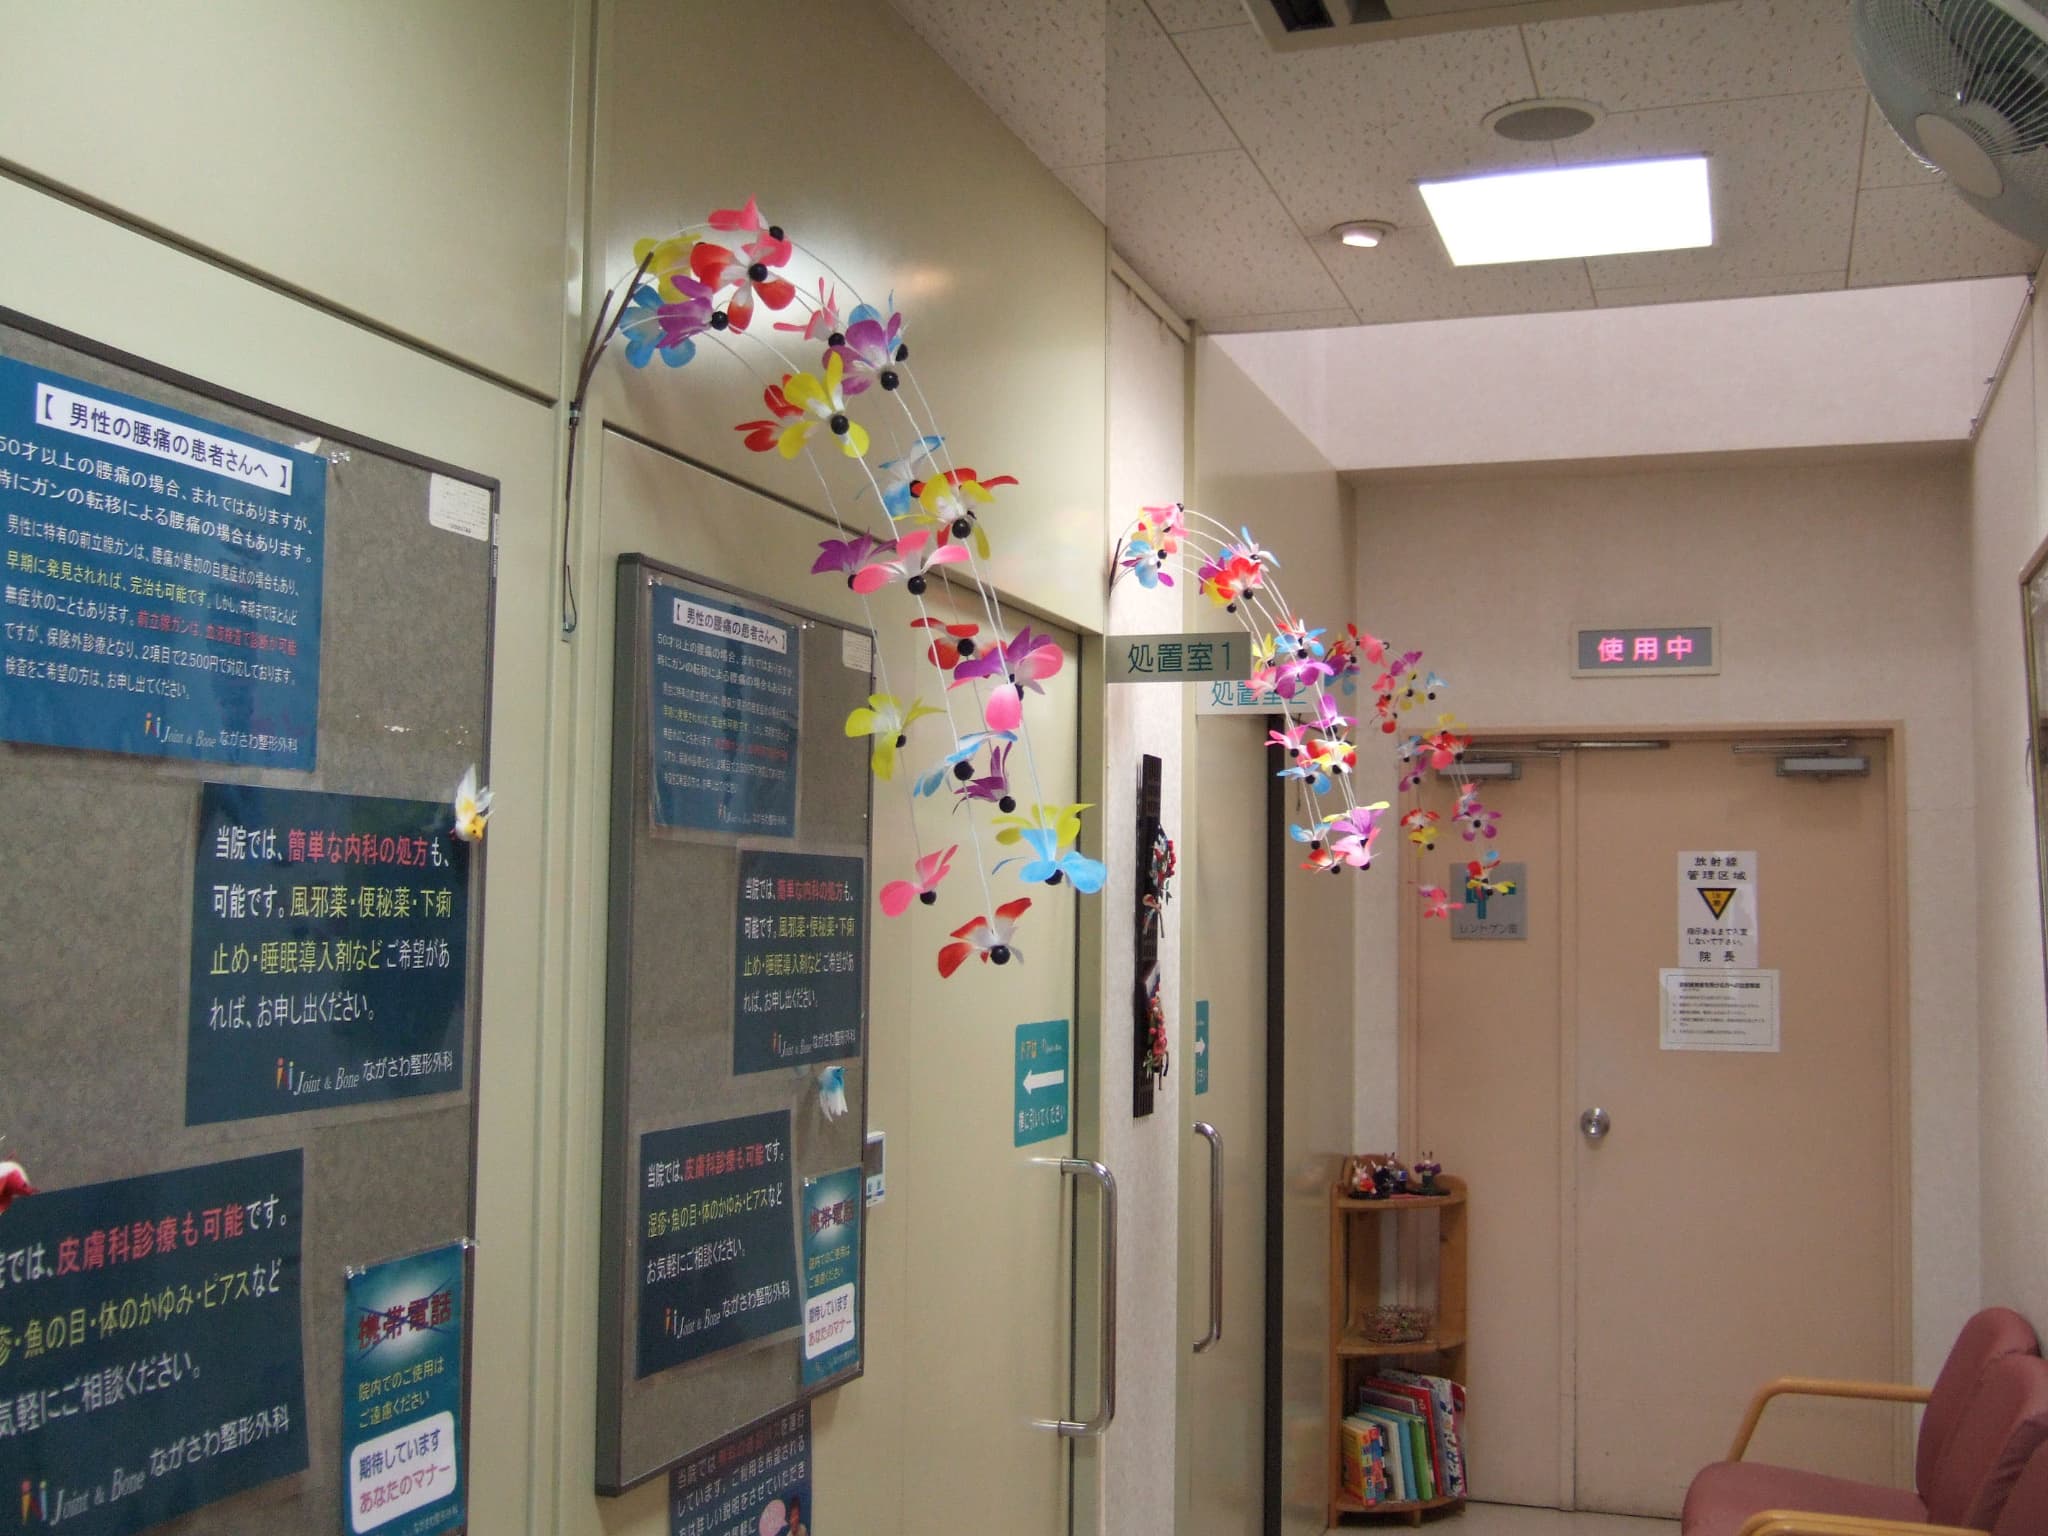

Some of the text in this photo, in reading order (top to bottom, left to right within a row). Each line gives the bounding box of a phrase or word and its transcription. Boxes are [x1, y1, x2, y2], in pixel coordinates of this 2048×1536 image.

[1127, 641, 1231, 674] 処置室1
[1597, 635, 1693, 663] 使用中
[210, 991, 375, 1031] れば、お申し出ください。
[293, 1050, 453, 1095] Joint & Bone ながさわ整形外科
[722, 1280, 790, 1318] ながさわ整形外科
[110, 1468, 146, 1502] Bone
[150, 1403, 290, 1477] ながさわ整形外科
[359, 1427, 441, 1482] 期待しています
[360, 1463, 451, 1514] あなたのマナー
